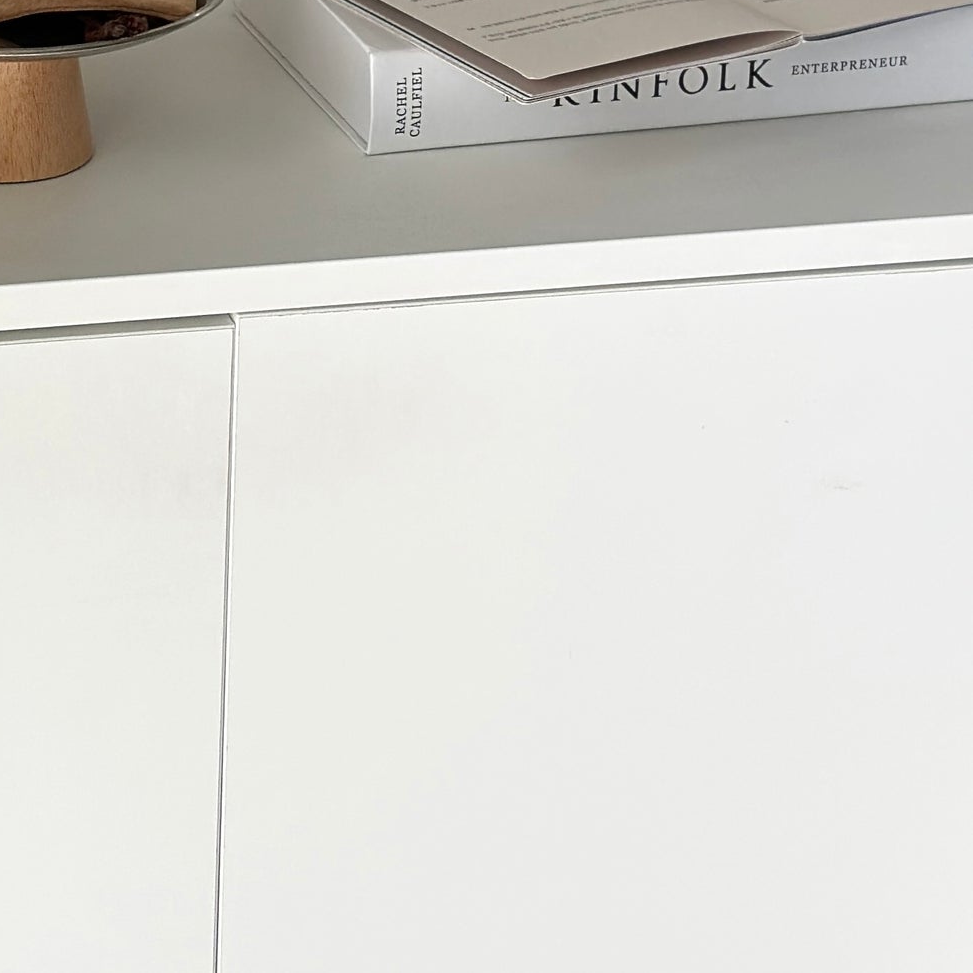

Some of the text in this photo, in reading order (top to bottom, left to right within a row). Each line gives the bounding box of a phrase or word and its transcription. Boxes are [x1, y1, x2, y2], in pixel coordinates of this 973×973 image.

[791, 55, 908, 76] ENTERPRENEUR
[394, 77, 408, 135] RACHEL
[409, 67, 423, 138] CAULFIEL
